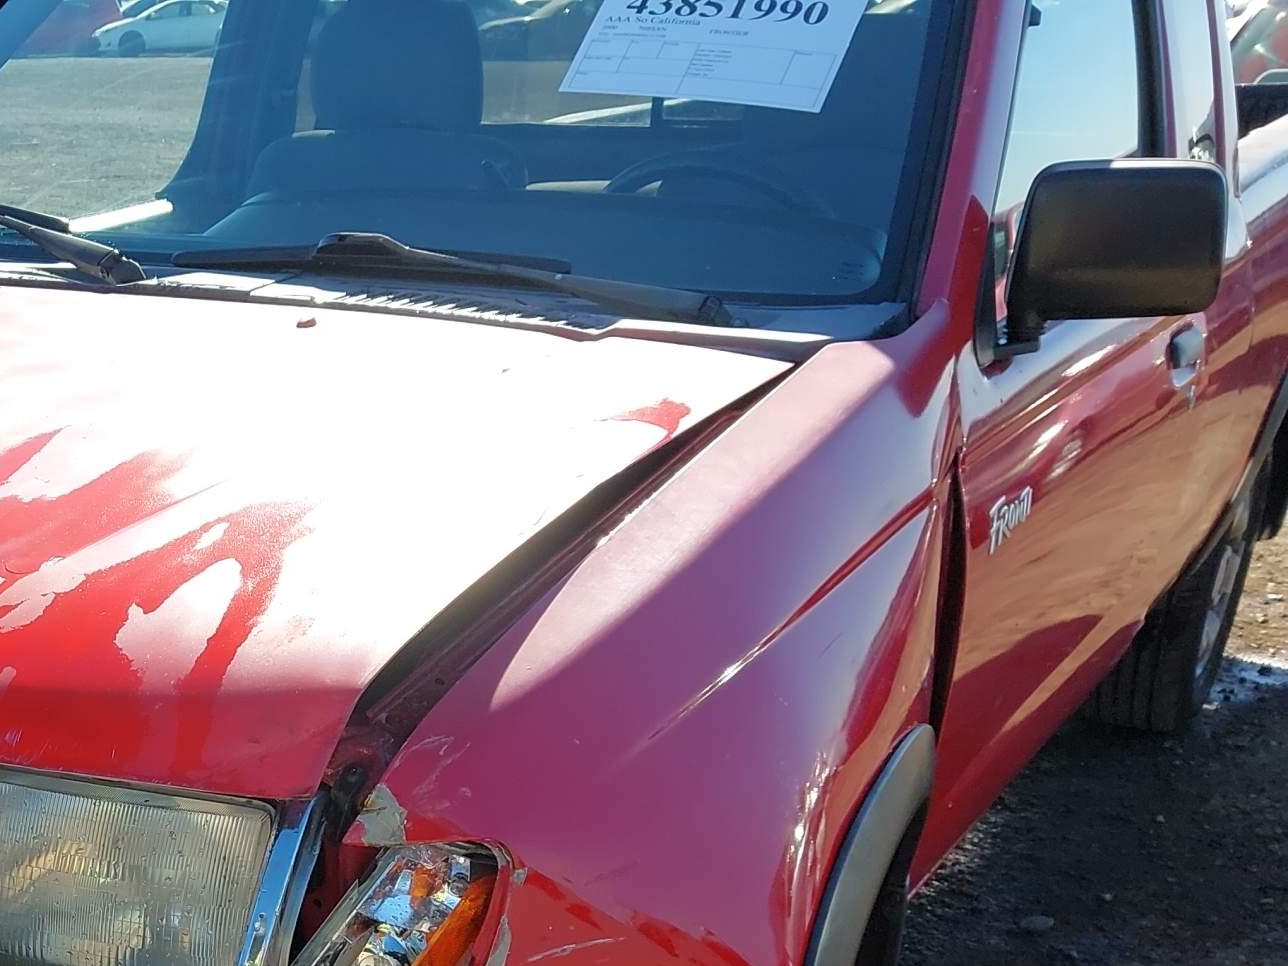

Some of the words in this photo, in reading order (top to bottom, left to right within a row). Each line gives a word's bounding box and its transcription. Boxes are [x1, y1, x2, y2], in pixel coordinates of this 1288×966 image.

[606, 15, 630, 23] AAA
[650, 16, 701, 26] California
[626, 0, 829, 25] 43851990
